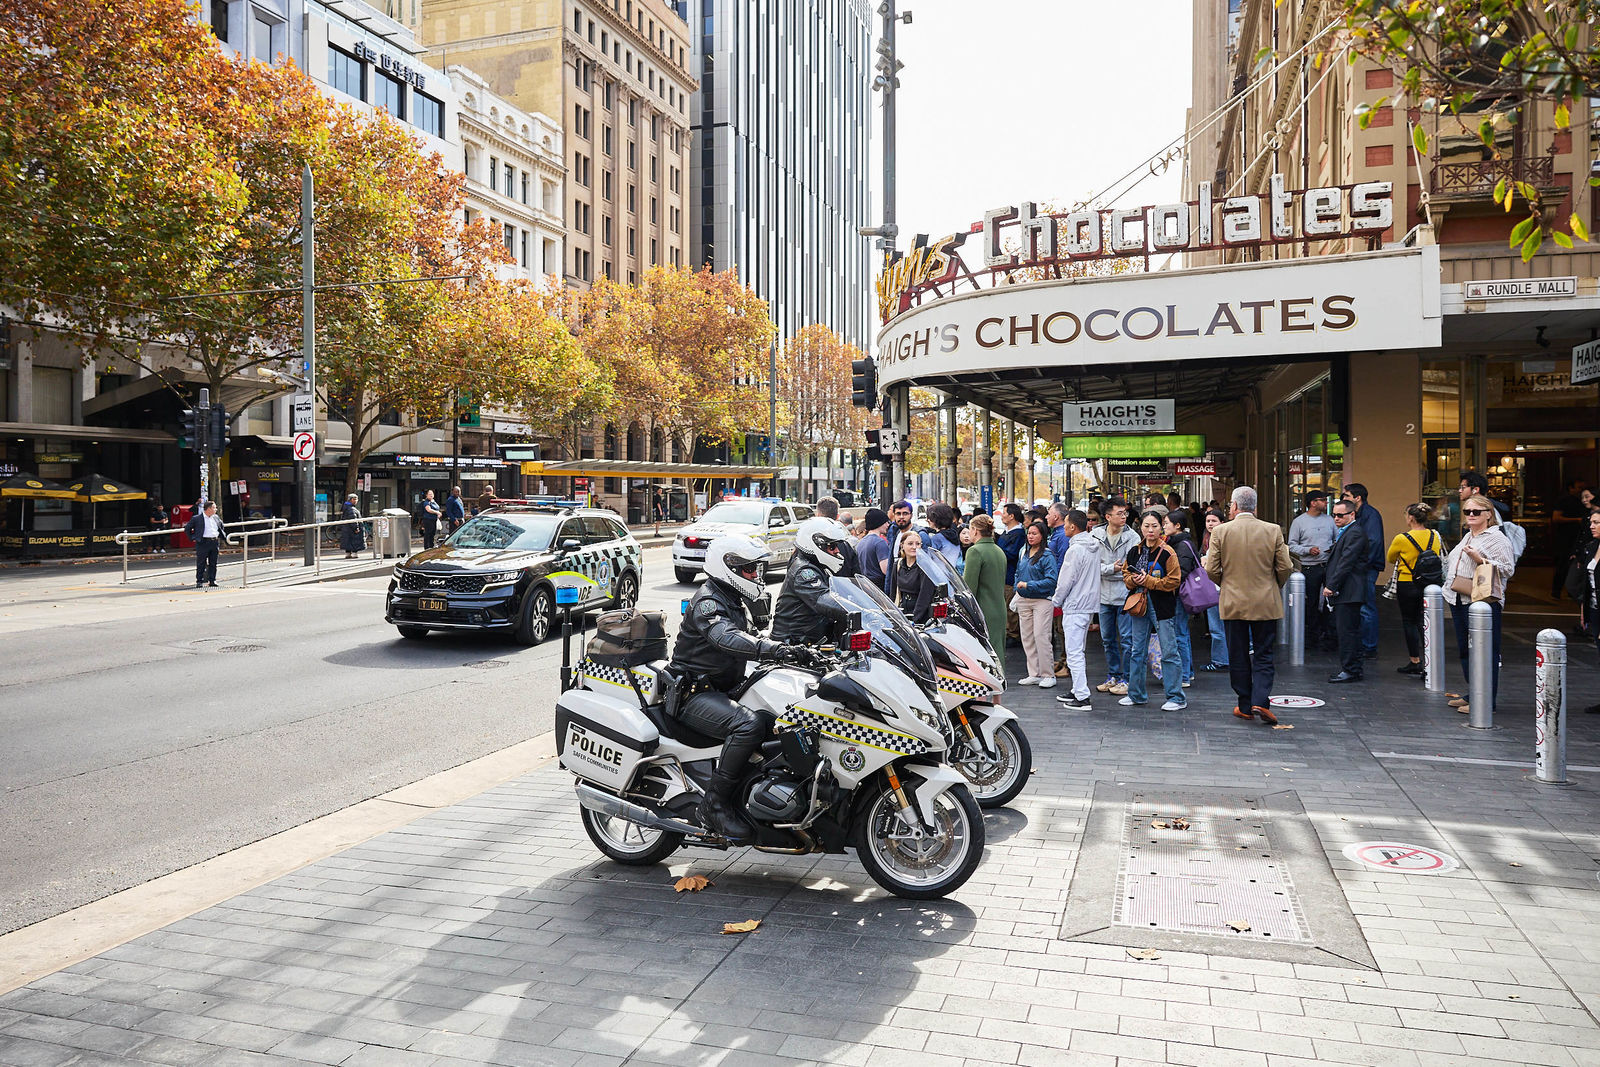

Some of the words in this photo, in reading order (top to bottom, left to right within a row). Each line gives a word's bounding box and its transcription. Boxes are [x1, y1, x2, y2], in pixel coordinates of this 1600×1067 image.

[1486, 283, 1532, 296] RUNDLE
[1538, 281, 1569, 294] MALL
[880, 323, 960, 369] HAIGH'S
[975, 294, 1357, 349] CHOCOLATES
[1576, 342, 1600, 368] HAIG
[1080, 405, 1156, 418] HAIGH'S
[295, 416, 312, 425] LANE
[1080, 419, 1156, 427] CHOCOLATES
[1405, 425, 1415, 435] 2
[1095, 441, 1112, 451] OP
[1177, 465, 1215, 474] MASSAGE
[28, 537, 57, 545] GUZMAN
[422, 600, 427, 609] Y
[571, 732, 623, 766] POLICE
[573, 750, 587, 761] SAFER
[587, 757, 619, 775] COMMUNITIES
